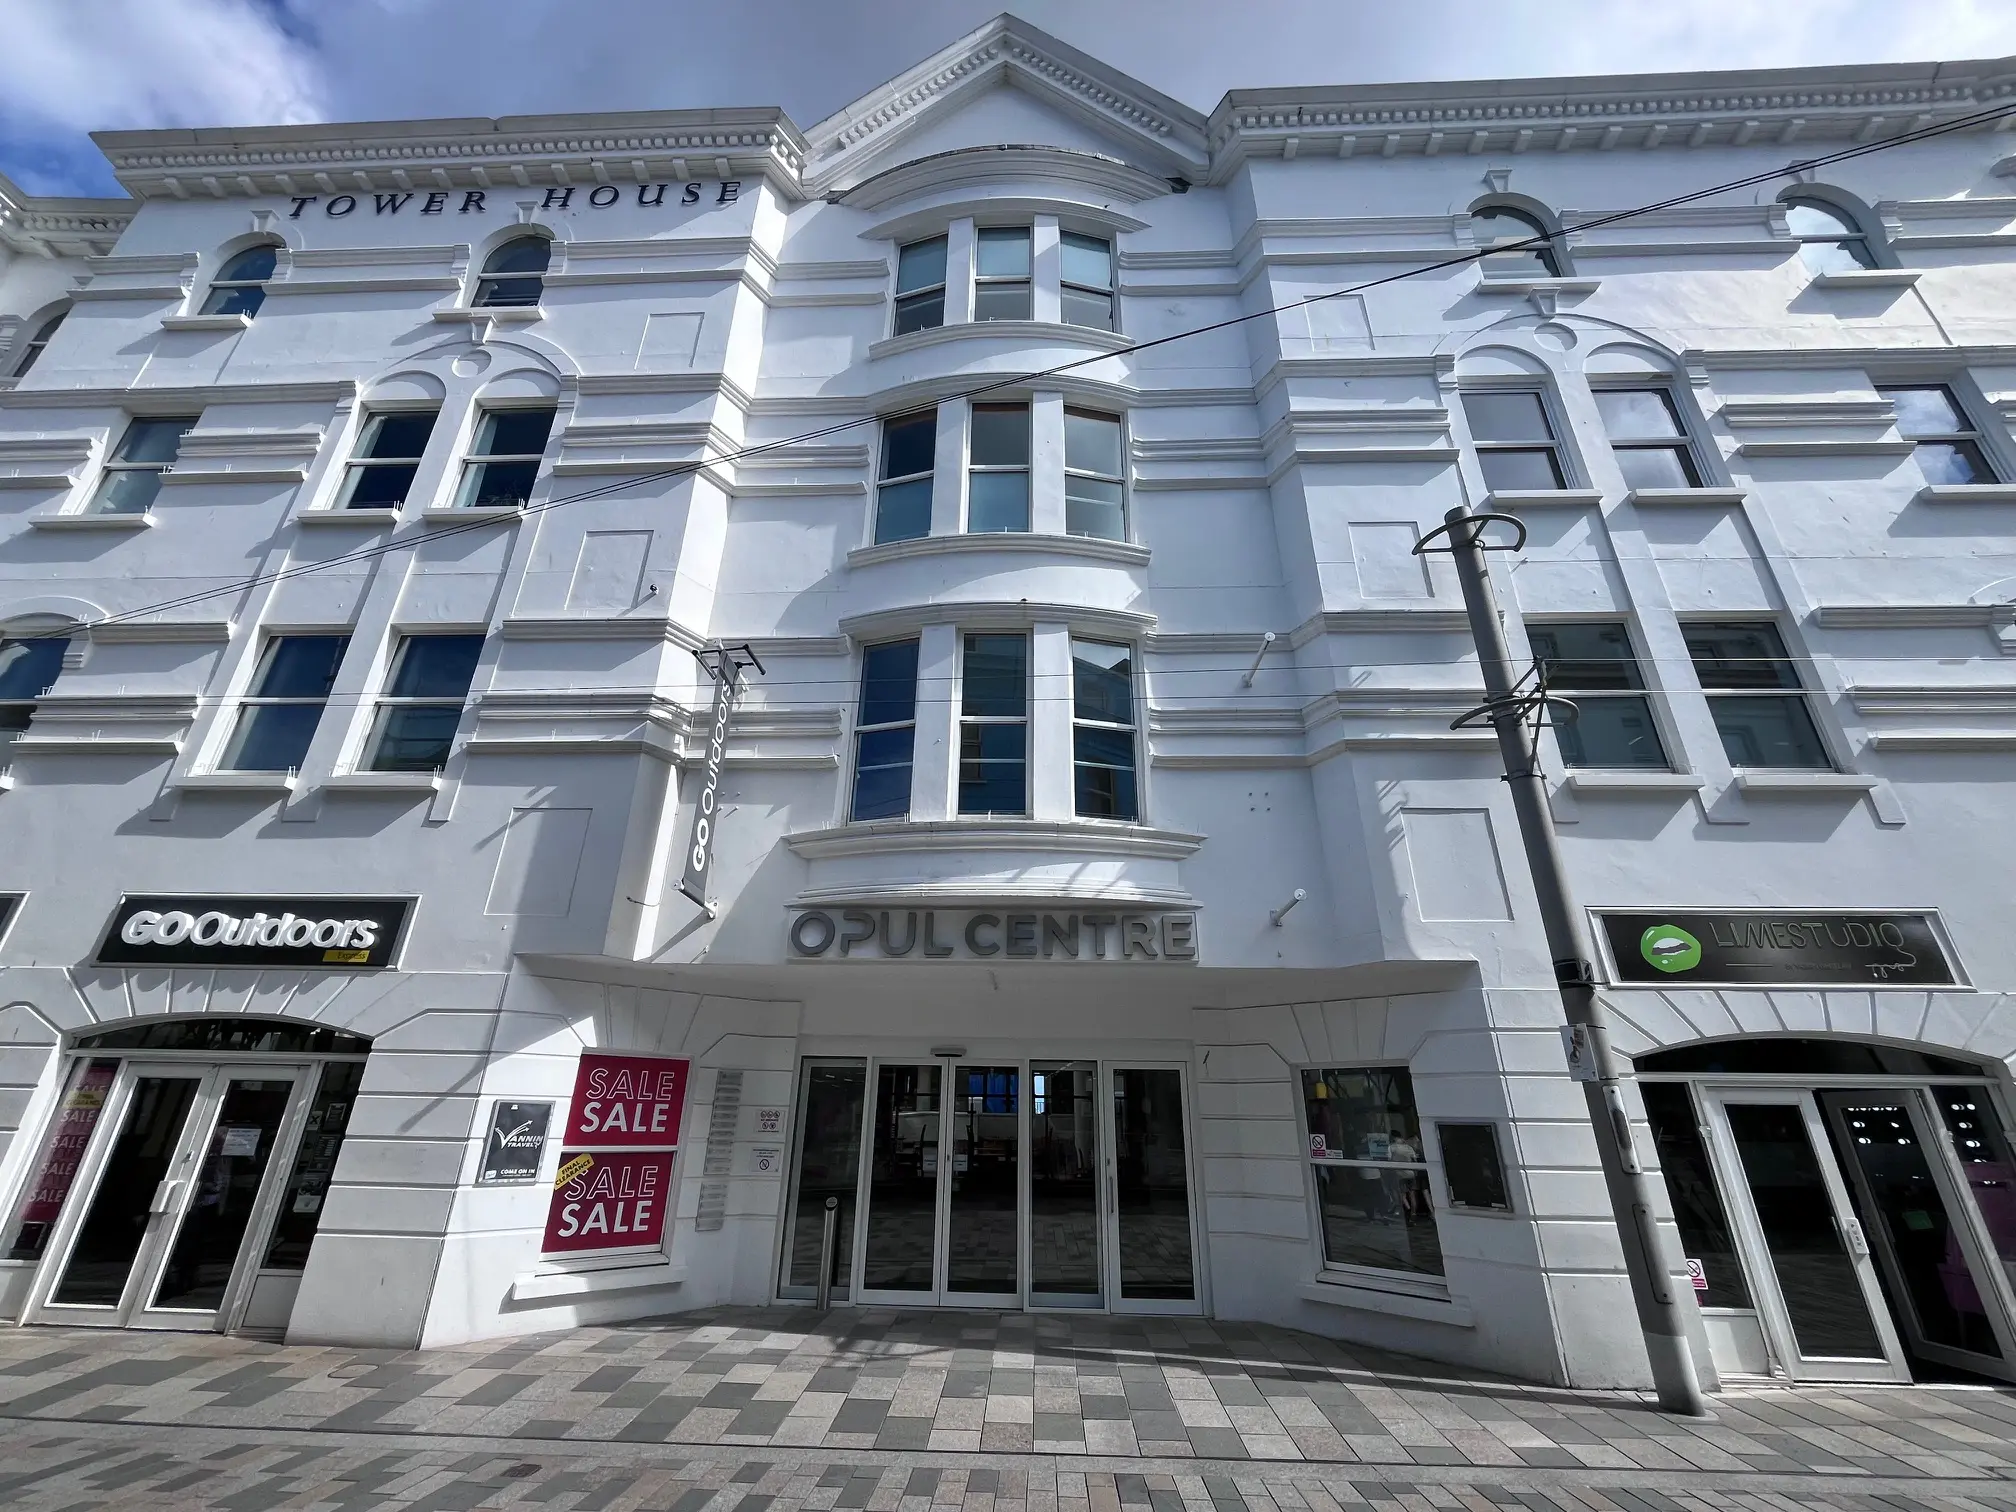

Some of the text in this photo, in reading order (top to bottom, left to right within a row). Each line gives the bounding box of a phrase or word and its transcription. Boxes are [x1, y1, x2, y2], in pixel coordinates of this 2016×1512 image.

[289, 181, 742, 219] TOWER HOUSE
[790, 911, 1196, 958] OPUL CENTRE
[586, 1067, 675, 1101] SALE
[60, 1109, 95, 1123] SALE
[580, 1101, 669, 1133] SALE
[50, 1134, 85, 1149] SALE
[40, 1162, 74, 1176] SALE
[555, 1159, 591, 1186] CLEARANCE
[561, 1160, 581, 1175] FINAL
[29, 1188, 65, 1203] SALE
[564, 1166, 659, 1201] SALE
[557, 1200, 652, 1238] SALE
